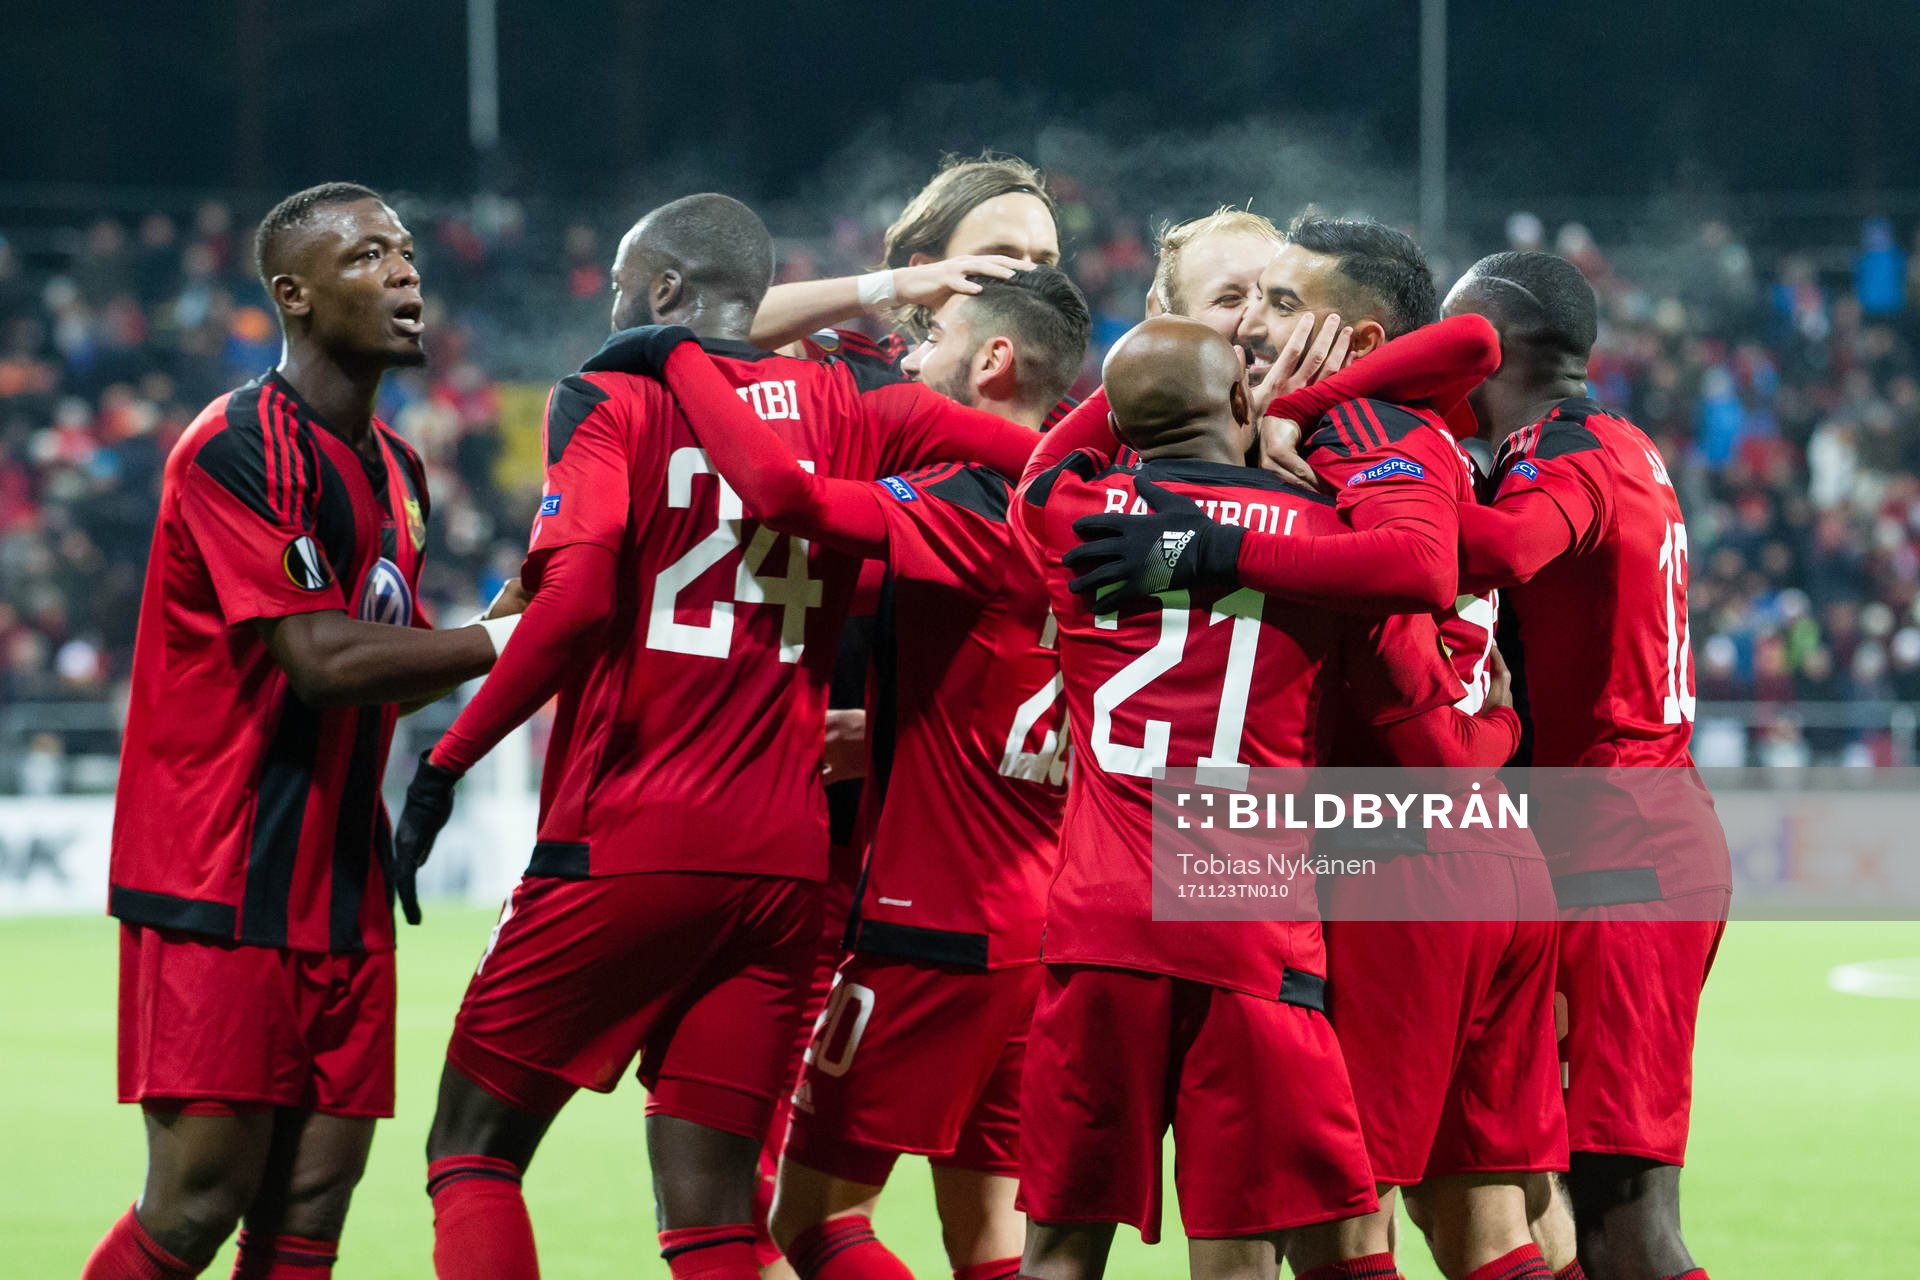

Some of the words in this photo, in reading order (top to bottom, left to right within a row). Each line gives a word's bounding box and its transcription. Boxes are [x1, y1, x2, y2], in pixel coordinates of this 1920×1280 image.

[1368, 461, 1423, 479] RESPECT
[645, 446, 823, 663] 24
[1168, 529, 1196, 568] adidas
[1090, 587, 1265, 792] 21
